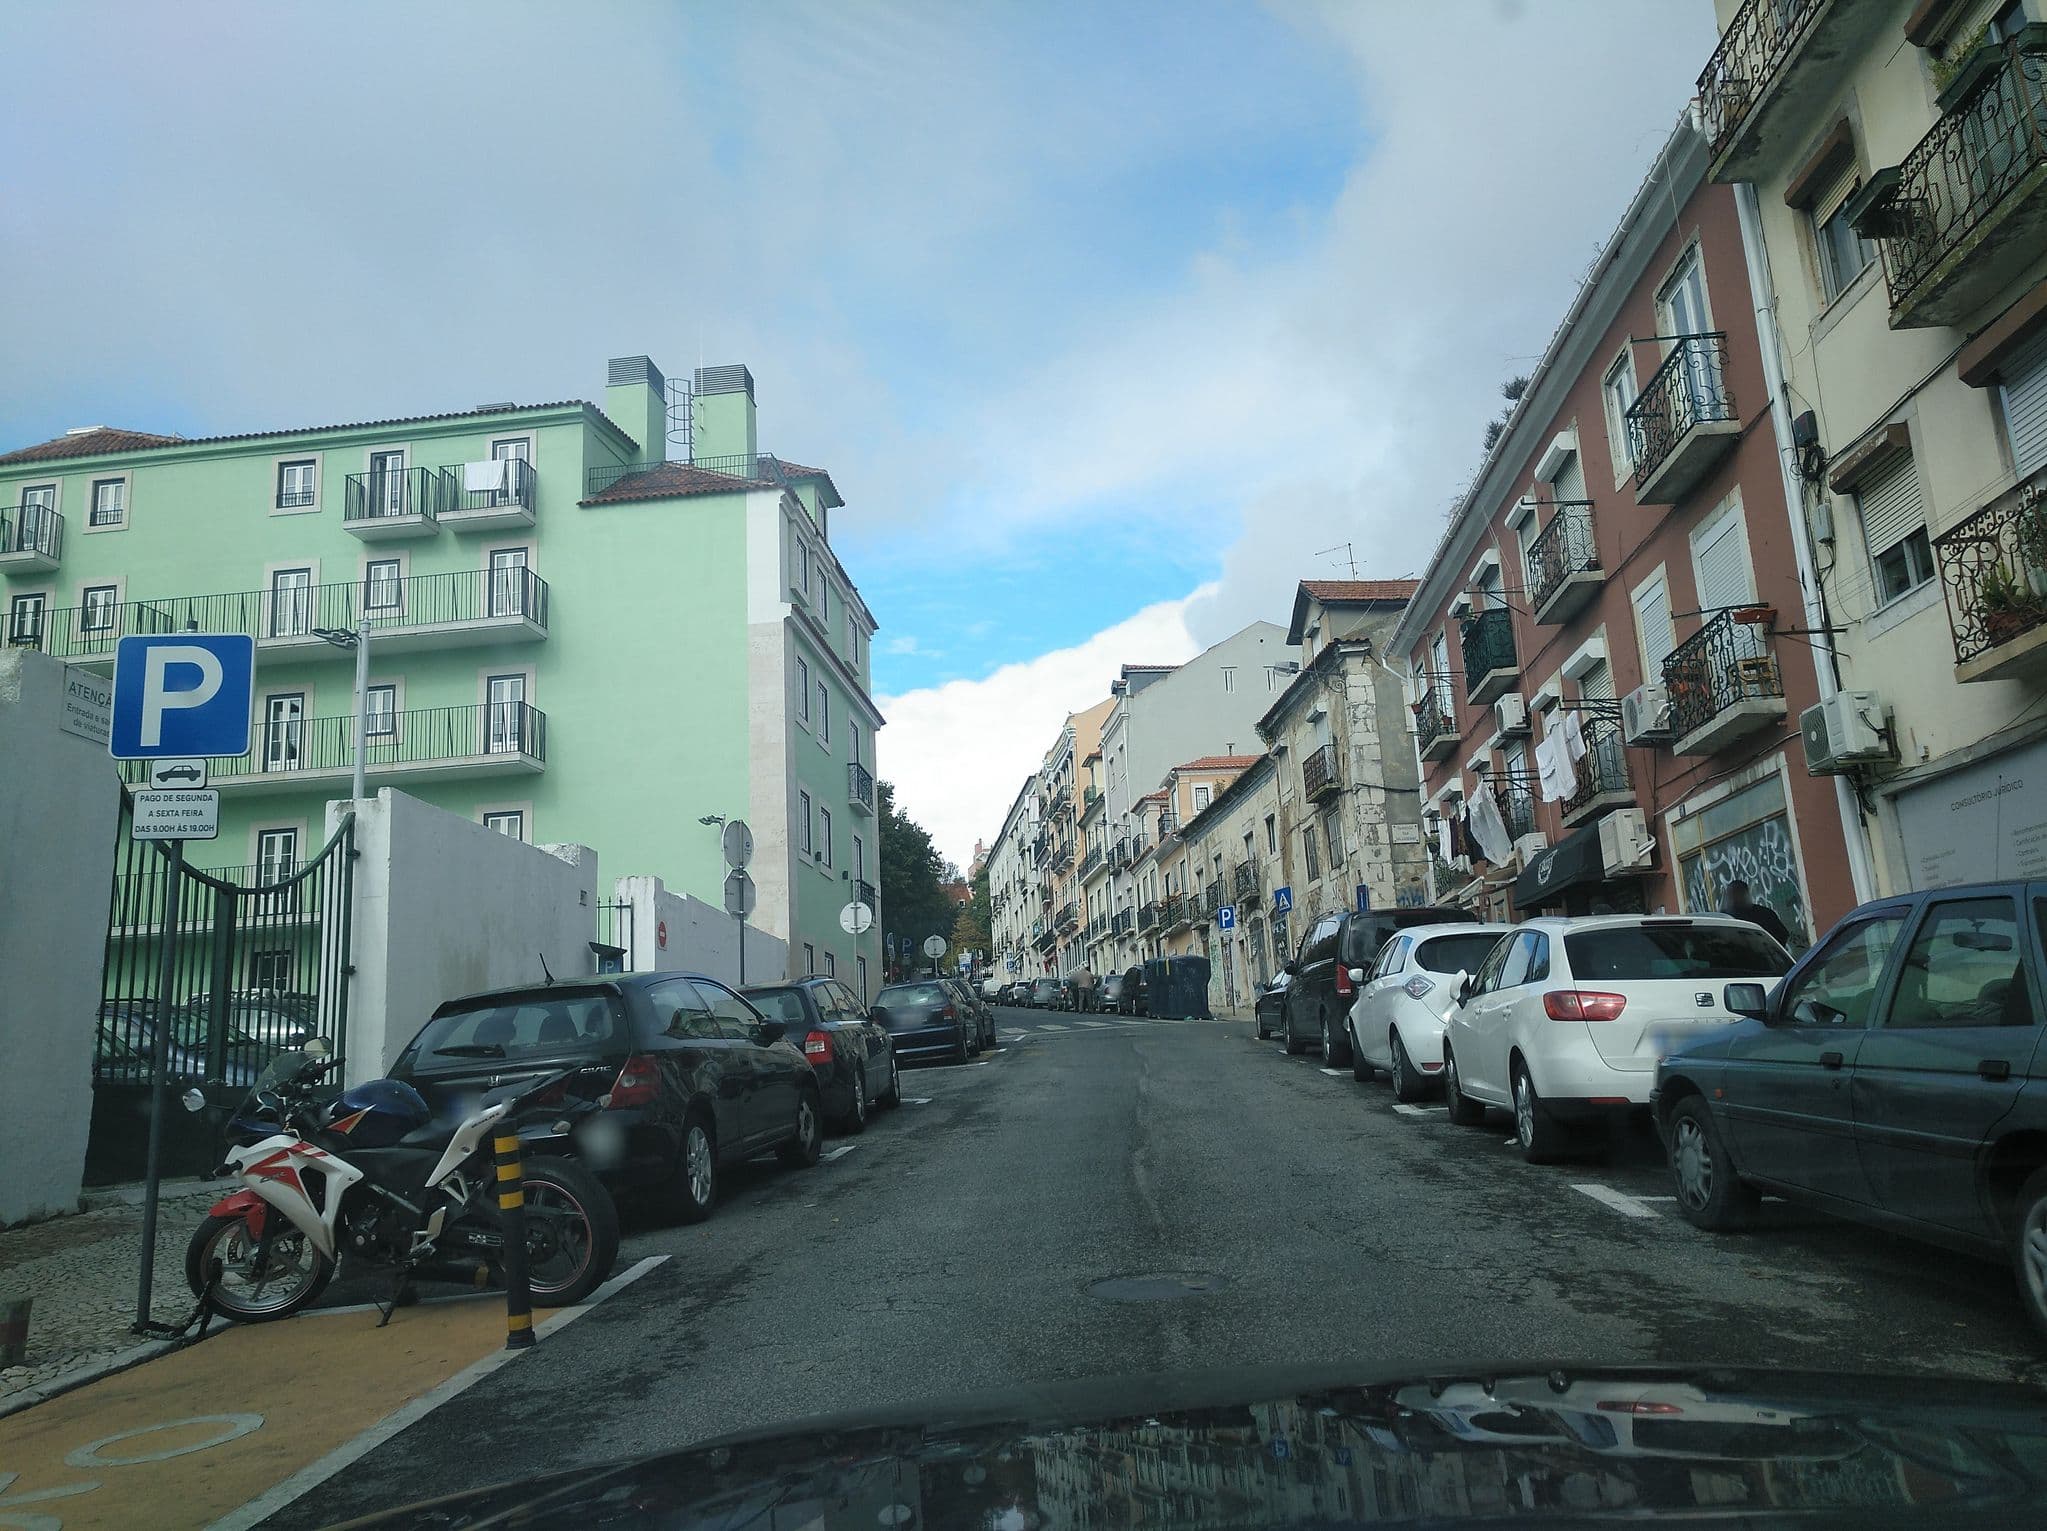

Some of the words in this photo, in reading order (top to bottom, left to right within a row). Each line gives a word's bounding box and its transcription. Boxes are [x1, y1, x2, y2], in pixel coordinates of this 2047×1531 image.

[68, 681, 112, 708] ATENÇÃ
[140, 646, 223, 747] P
[176, 794, 213, 802] SEGUNDA
[182, 809, 204, 817] FEIRA
[135, 825, 151, 833] DAS
[1222, 909, 1231, 927] P
